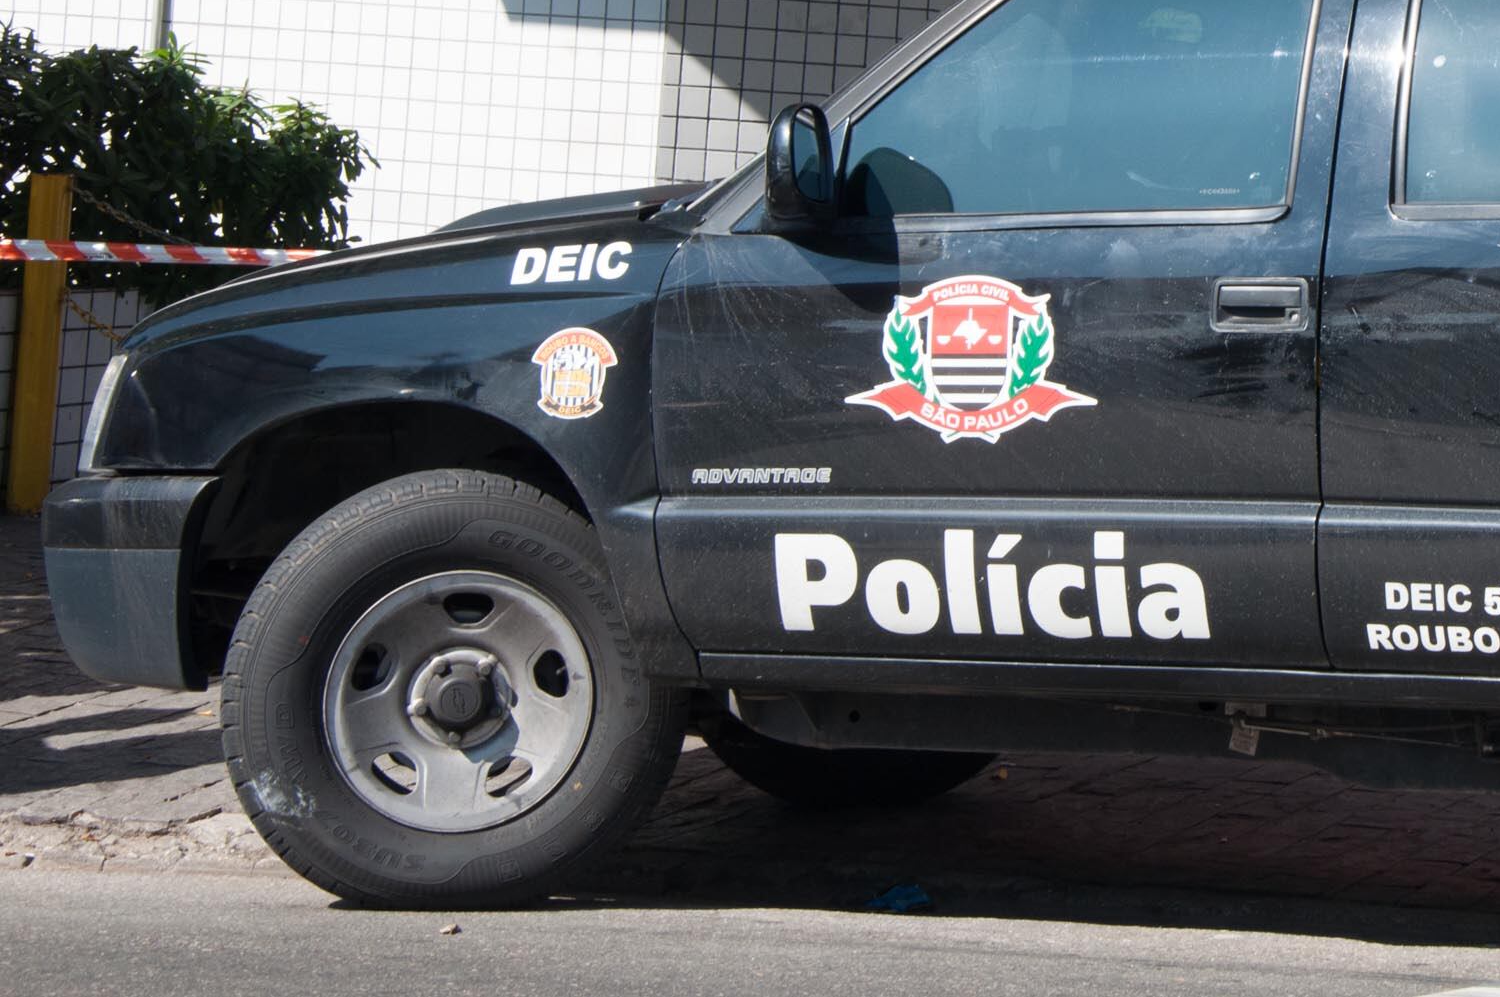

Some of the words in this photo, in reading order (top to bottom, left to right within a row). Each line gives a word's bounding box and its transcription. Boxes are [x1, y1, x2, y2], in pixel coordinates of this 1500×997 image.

[510, 241, 633, 285] DEIC
[933, 283, 979, 301] POLÍCIA
[981, 284, 1010, 301] CIVIL
[964, 398, 1029, 430] PAULO
[691, 467, 833, 485] ADVANTAGE
[774, 528, 1212, 640] Polícia
[1384, 581, 1473, 613] DEIC
[1366, 623, 1500, 654] ROUBO
